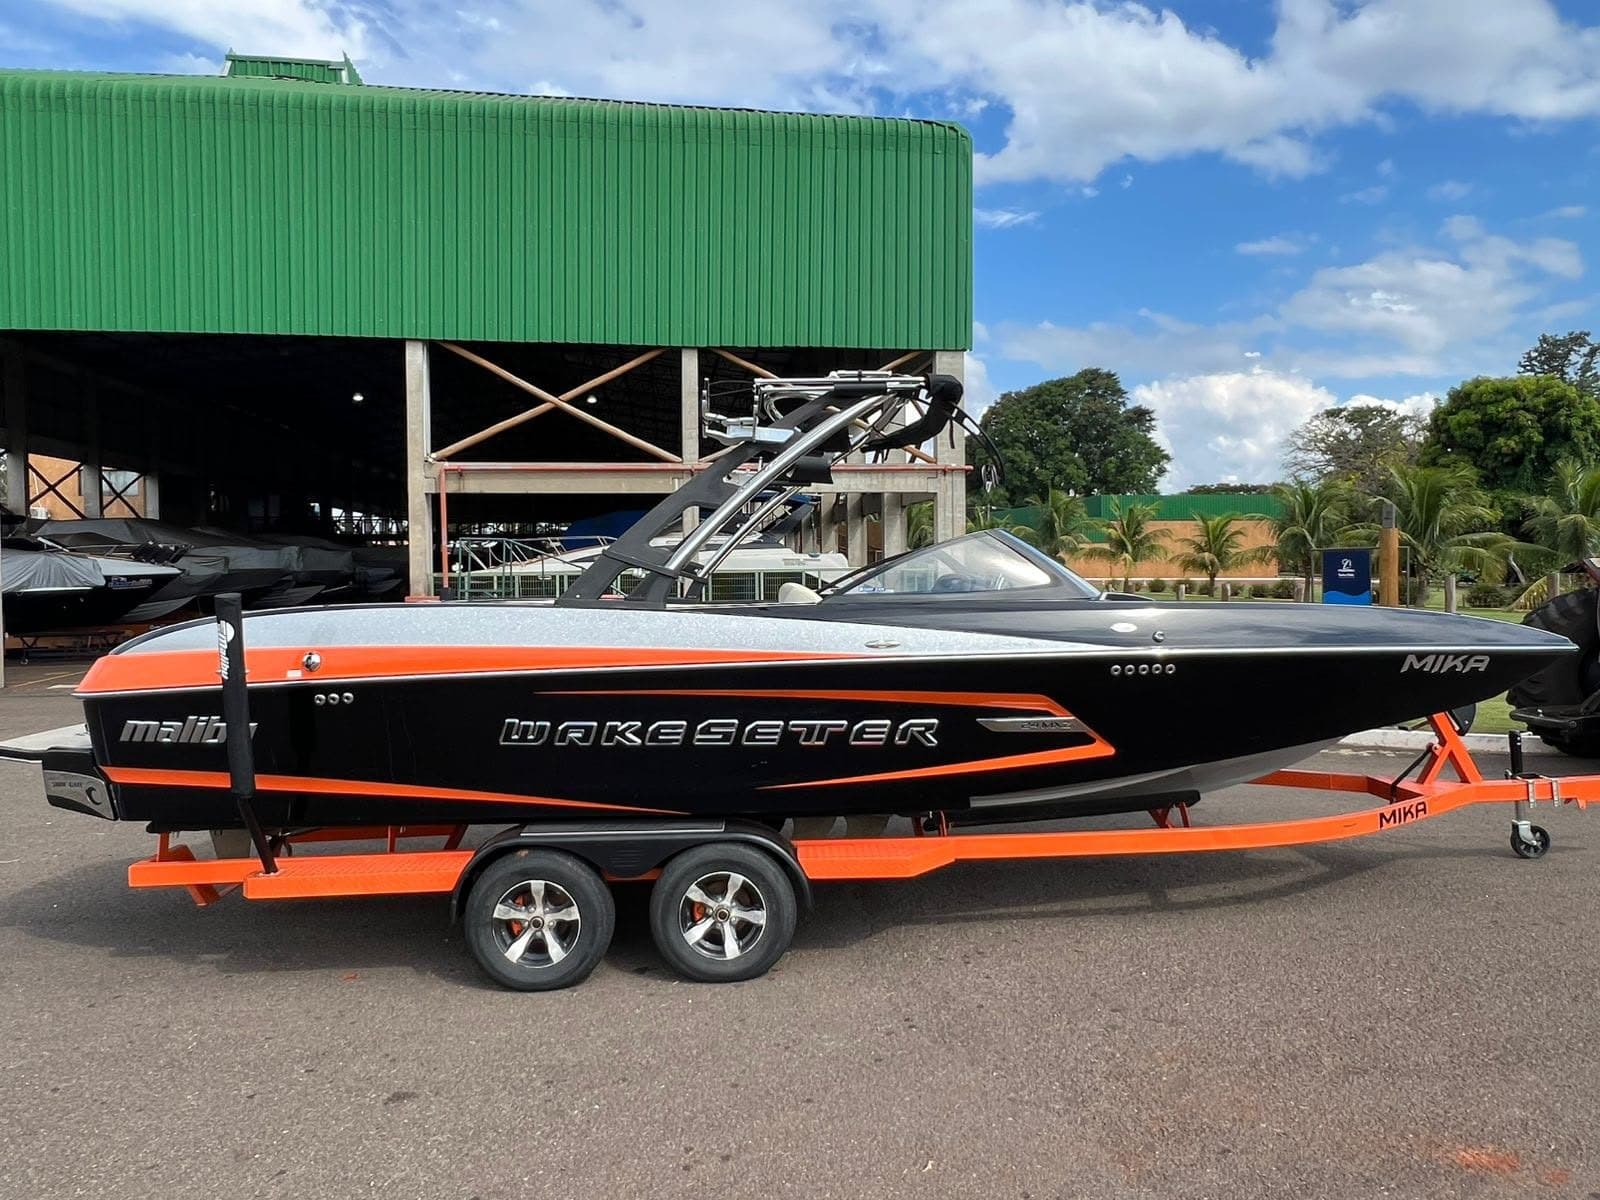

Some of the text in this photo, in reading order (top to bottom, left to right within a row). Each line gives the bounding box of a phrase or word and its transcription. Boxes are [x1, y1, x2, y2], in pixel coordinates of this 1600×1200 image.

[1400, 654, 1490, 673] MIKA
[499, 718, 939, 747] WAKESETTER
[1379, 801, 1427, 828] MIKA
